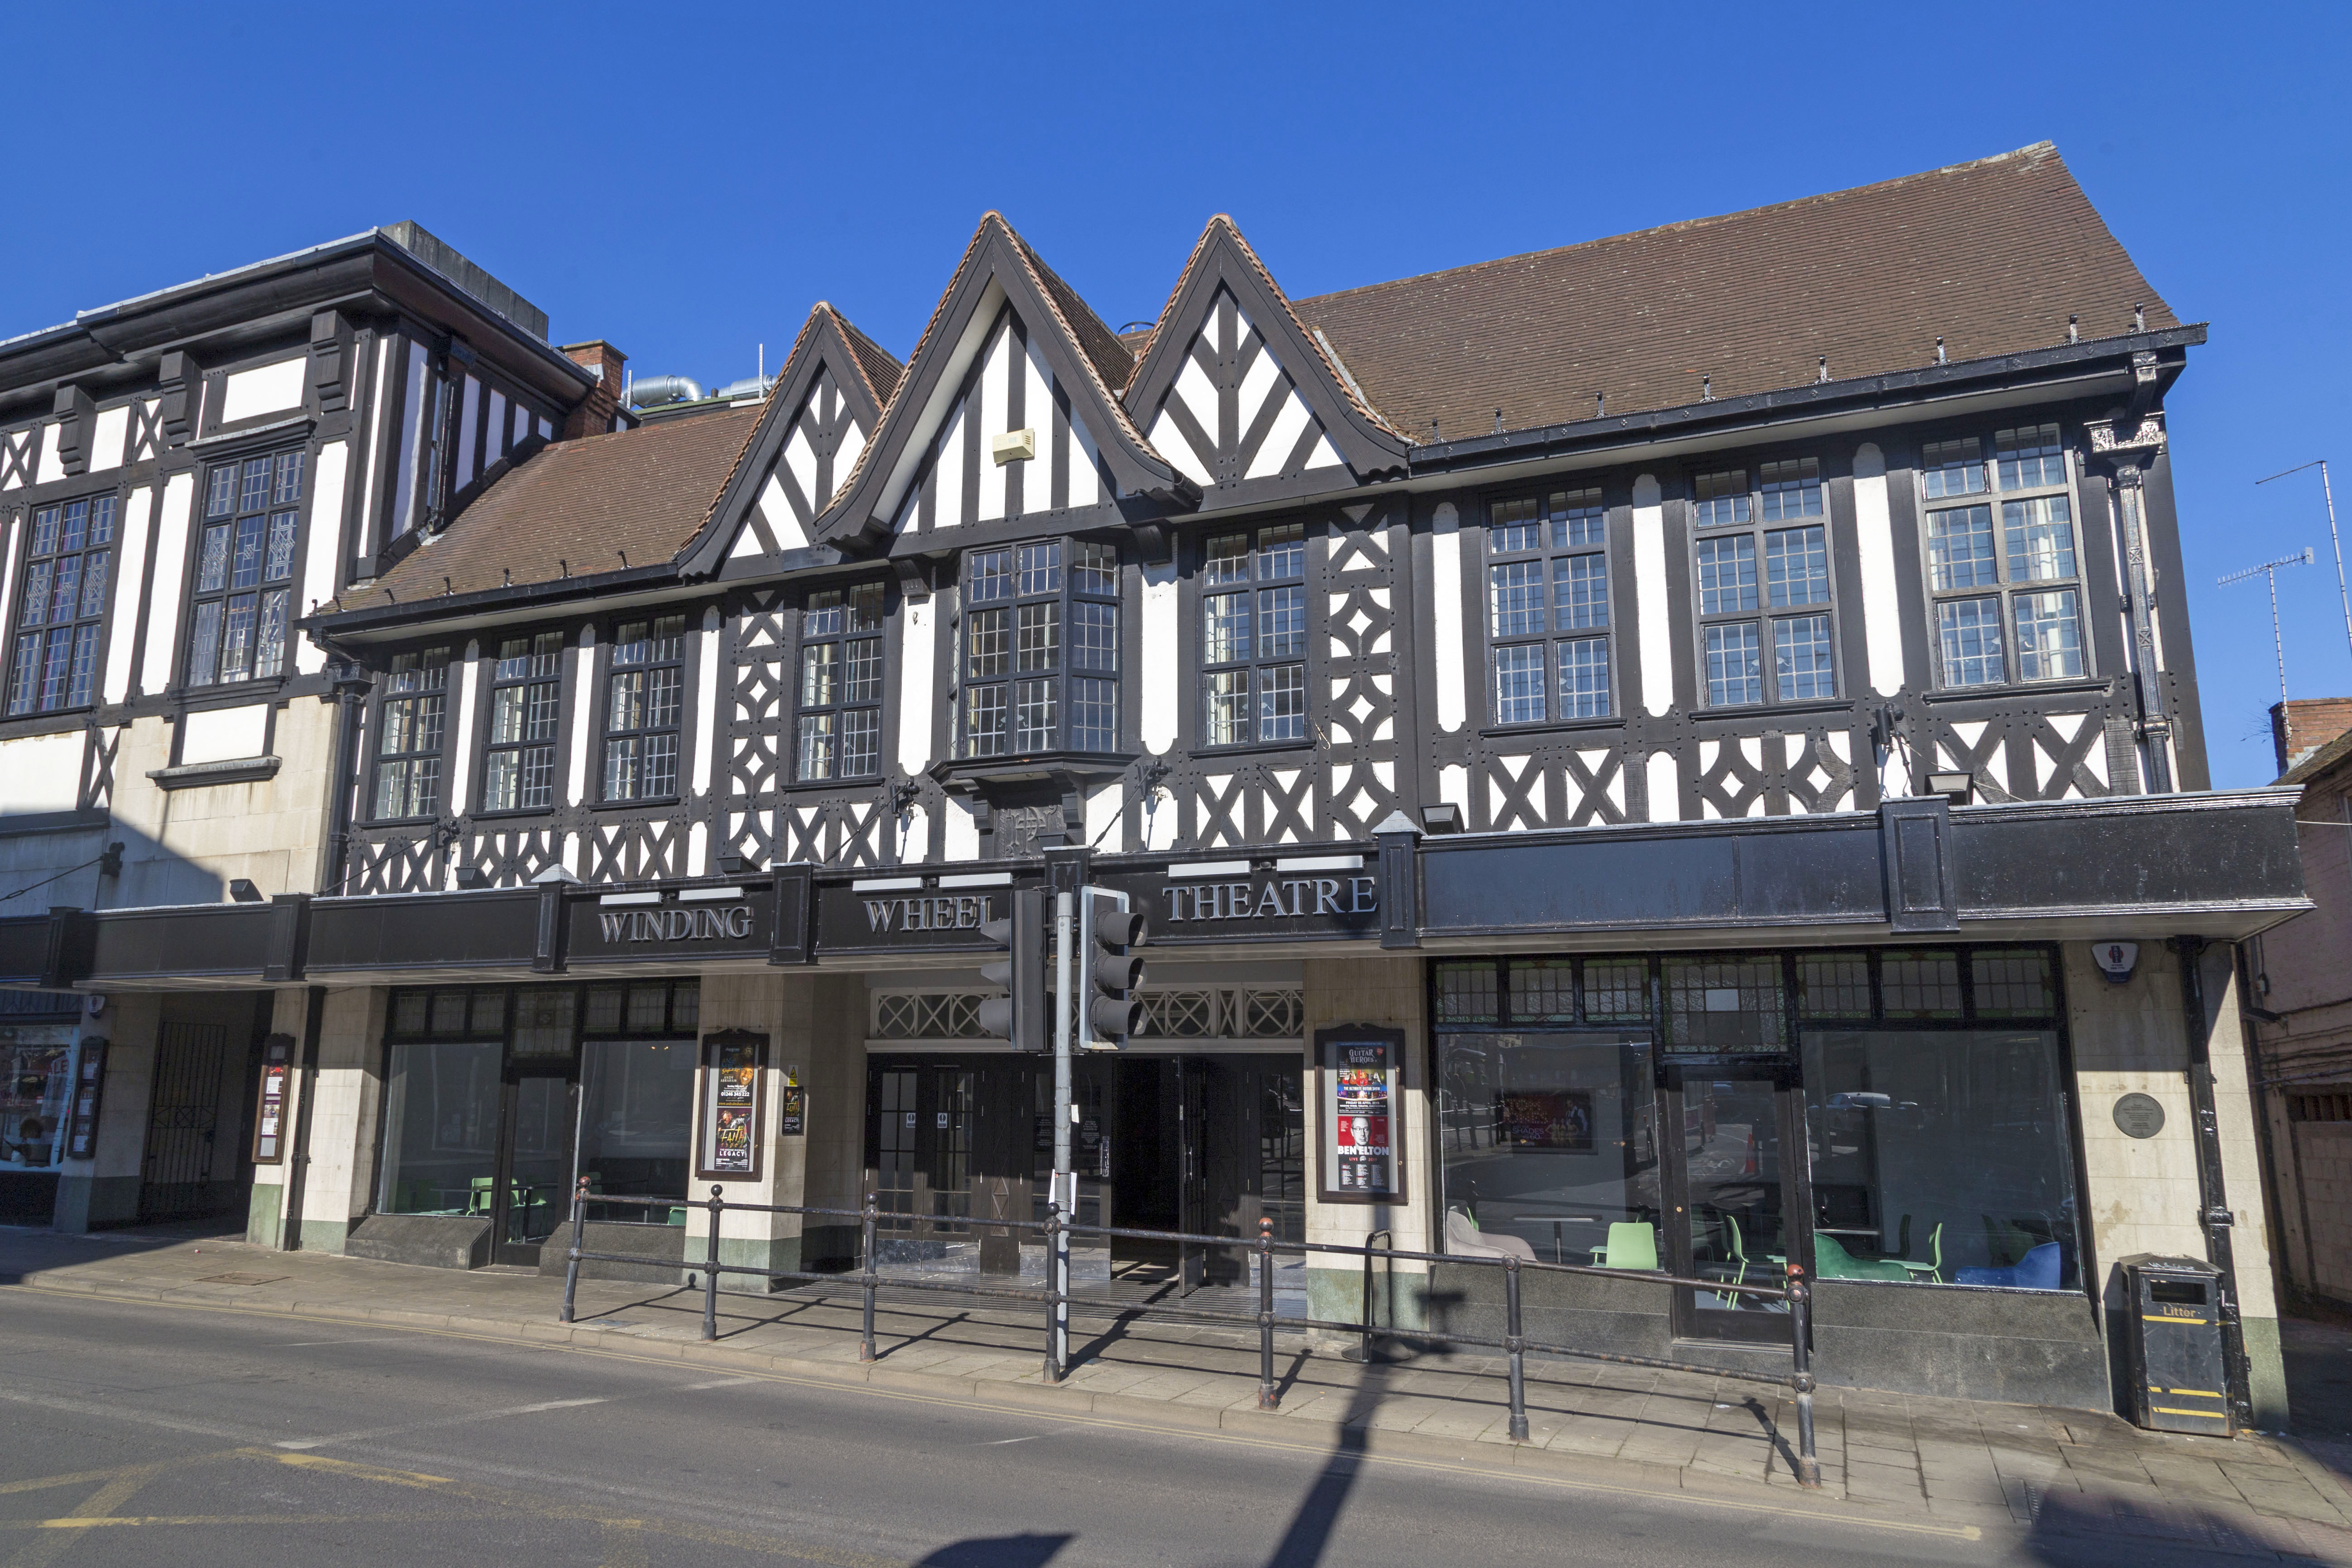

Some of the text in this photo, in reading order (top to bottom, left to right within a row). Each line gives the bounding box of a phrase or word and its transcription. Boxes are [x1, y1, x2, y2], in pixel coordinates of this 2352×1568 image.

[598, 906, 753, 943] WINDING
[1162, 876, 1377, 921] THEATRE
[1349, 1049, 1375, 1058] GUITAR
[1350, 1056, 1374, 1064] HEROES
[721, 1126, 745, 1143] FAITH
[1338, 1145, 1389, 1156] BEN ELTON
[2163, 1306, 2196, 1317] Litter
